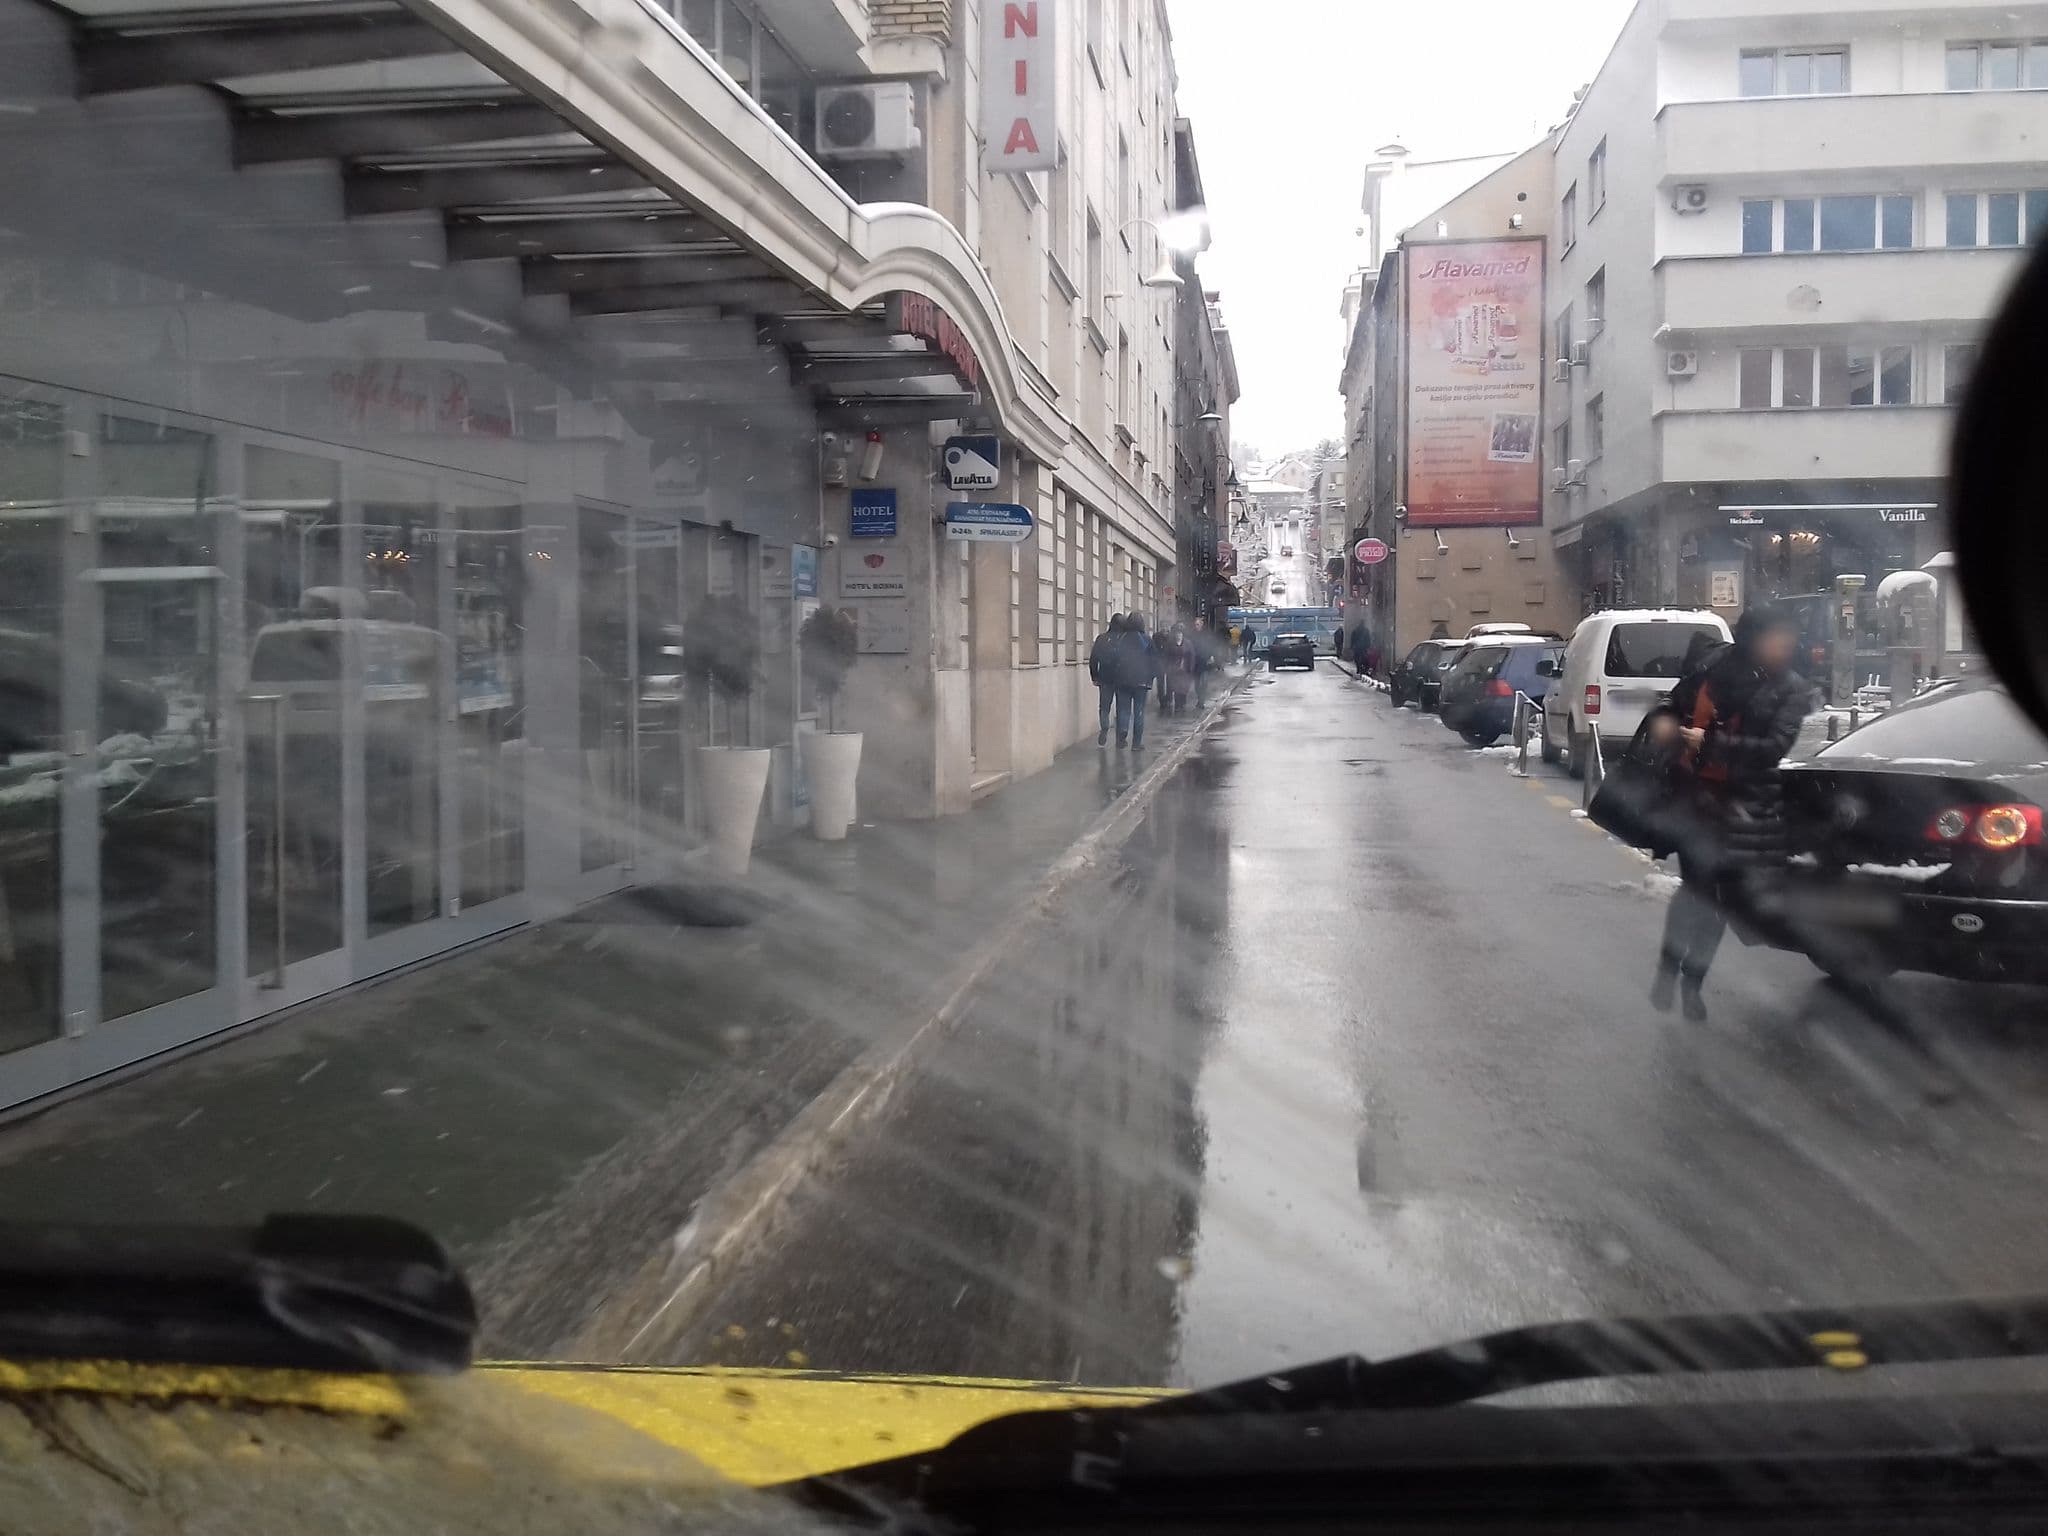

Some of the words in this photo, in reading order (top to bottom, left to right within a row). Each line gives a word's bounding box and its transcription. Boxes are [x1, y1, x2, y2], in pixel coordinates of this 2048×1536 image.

[1003, 1, 1040, 154] NIA
[1431, 256, 1531, 278] Flavamed
[853, 506, 894, 516] HOTEL
[1879, 509, 1926, 522] Vanilla
